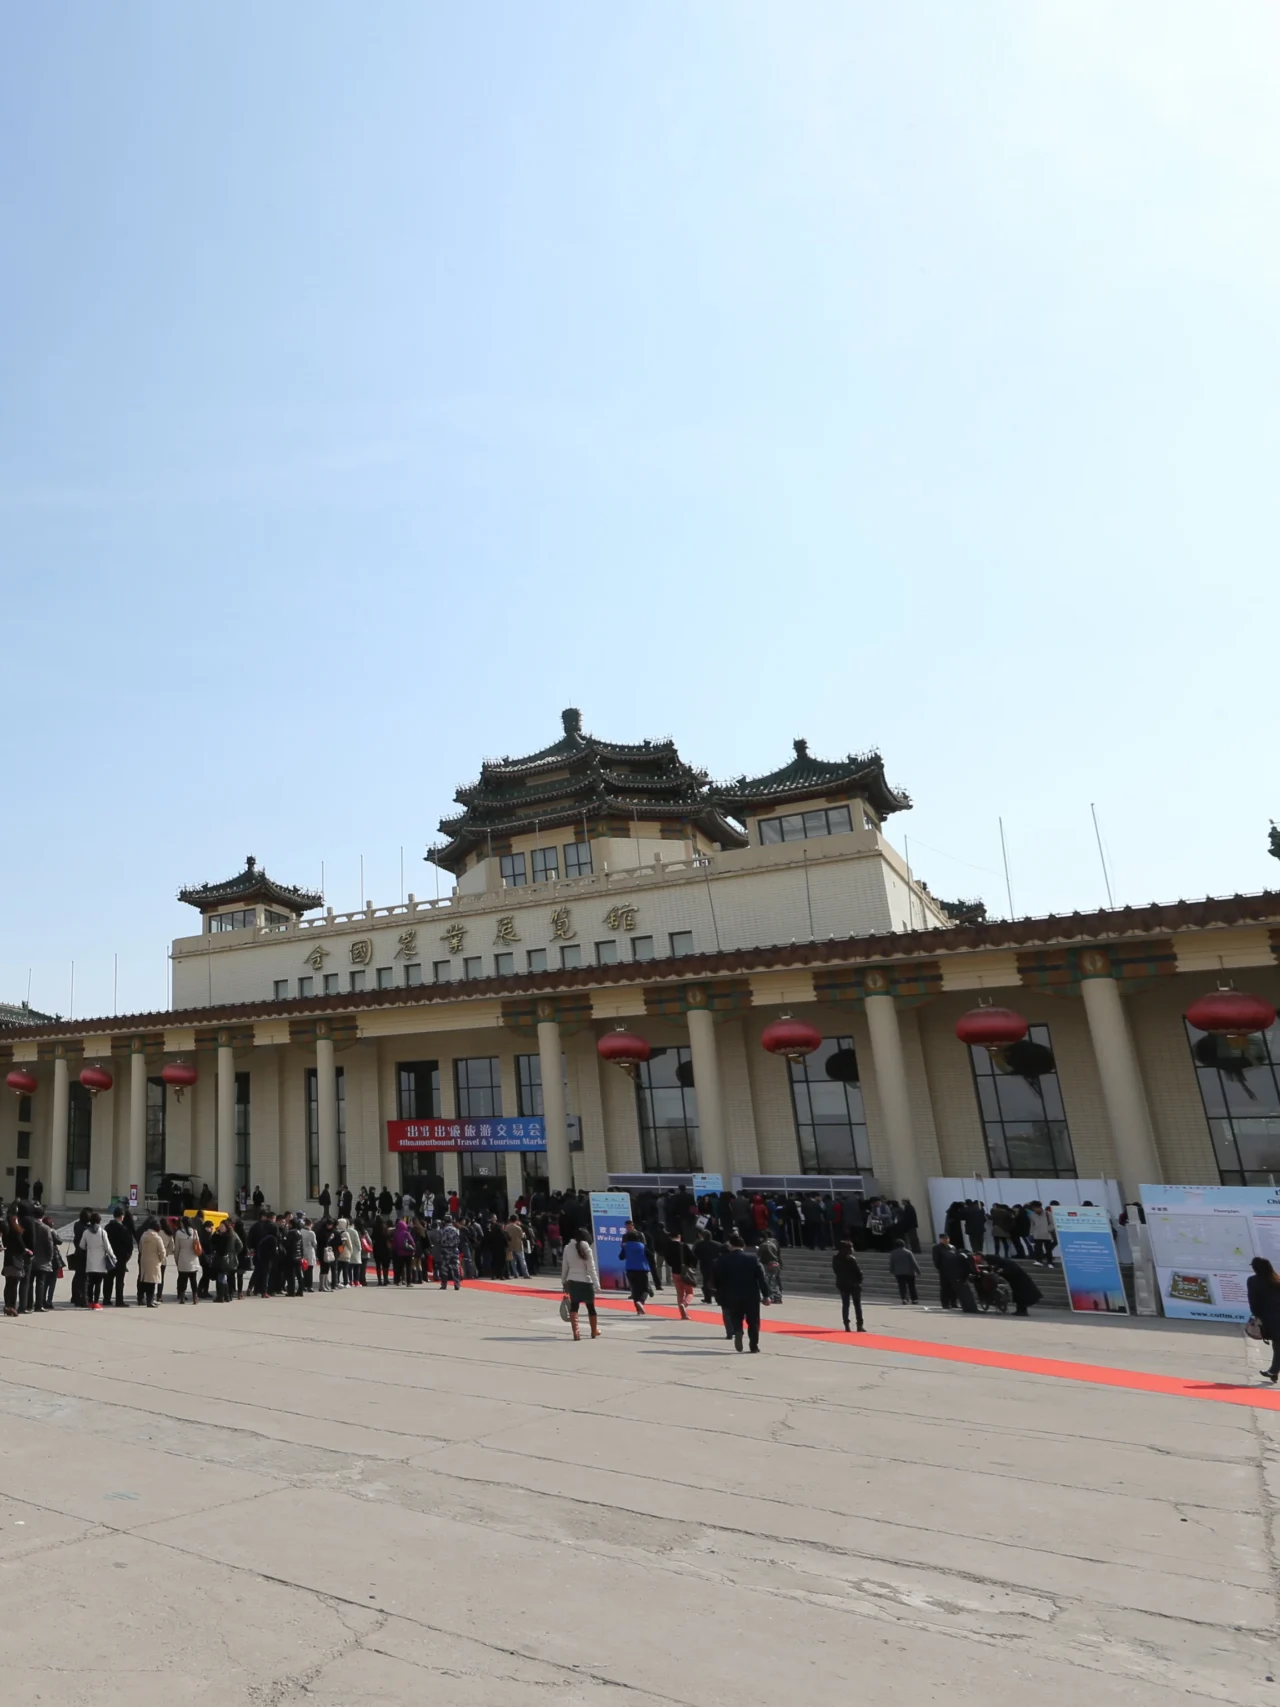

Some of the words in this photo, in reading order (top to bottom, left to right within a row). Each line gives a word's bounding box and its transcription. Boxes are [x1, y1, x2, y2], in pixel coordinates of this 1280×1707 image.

[457, 1137, 479, 1146] Travel
[482, 1137, 488, 1146] &
[489, 1136, 521, 1146] Tourism
[523, 1136, 548, 1146] Marke
